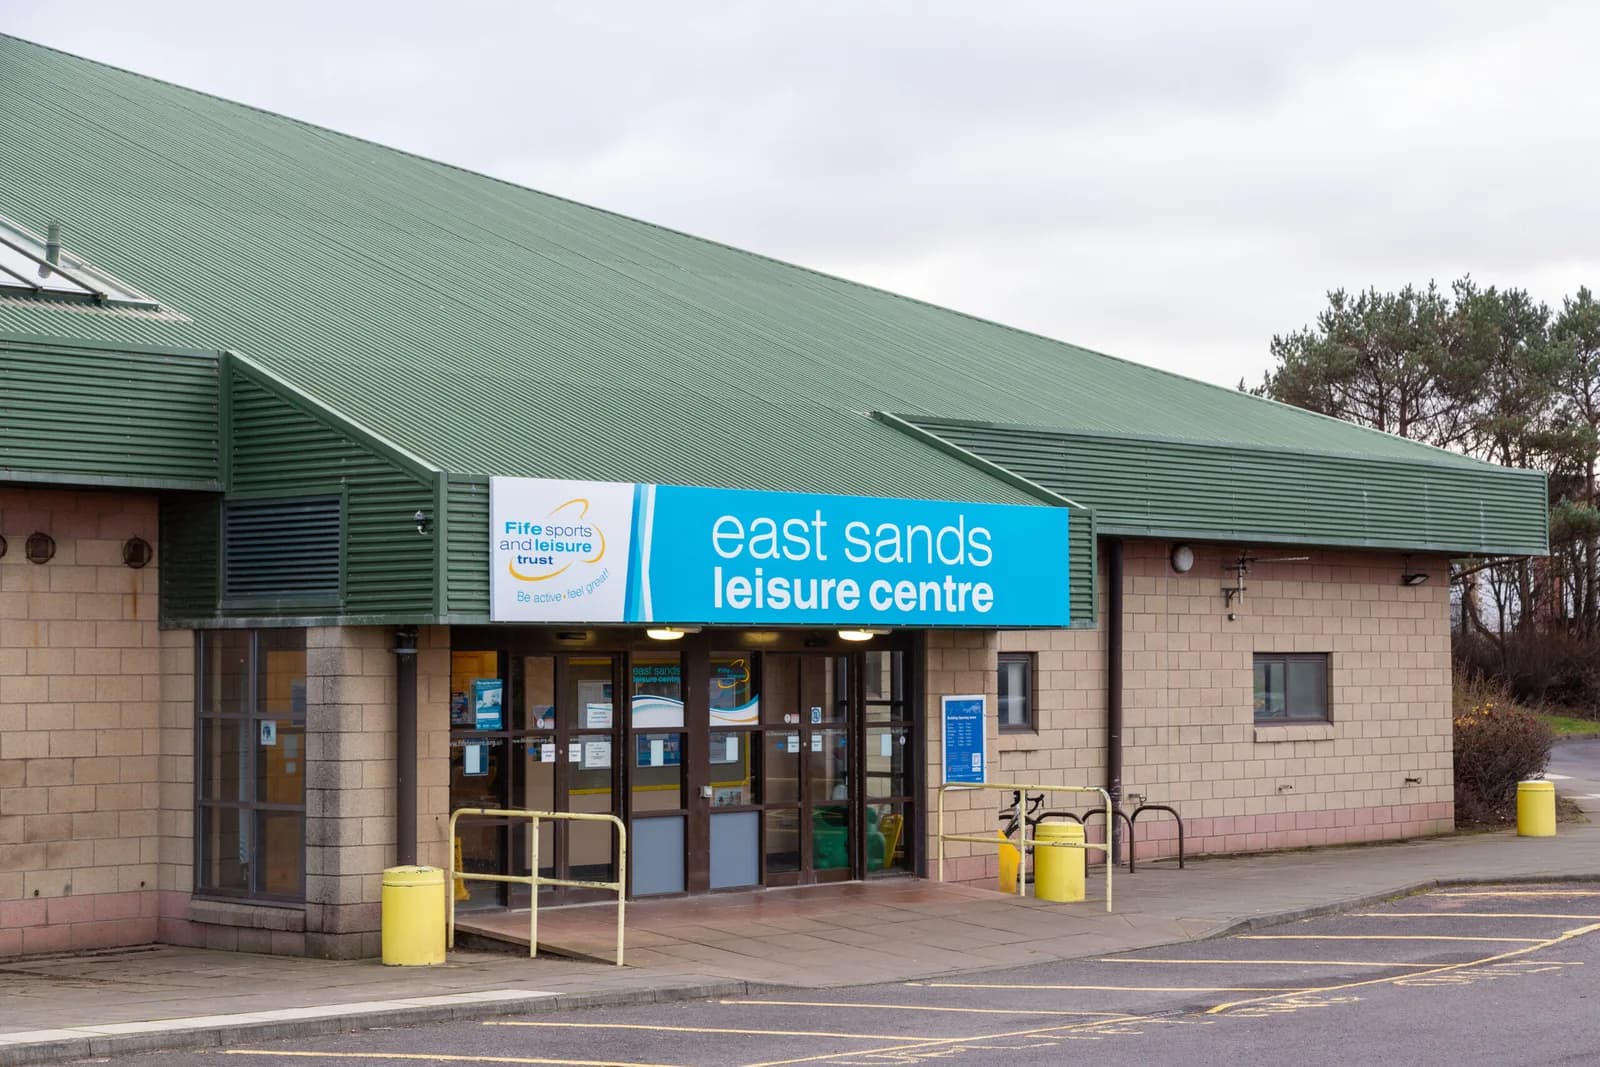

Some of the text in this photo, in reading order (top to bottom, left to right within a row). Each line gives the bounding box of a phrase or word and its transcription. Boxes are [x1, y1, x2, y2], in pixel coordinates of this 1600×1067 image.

[504, 521, 593, 539] Fife sports
[712, 509, 993, 567] east sands
[499, 538, 593, 553] and leisure
[516, 554, 554, 565] trust
[516, 568, 609, 604] Be active feel great!
[713, 566, 994, 612] leisure centre
